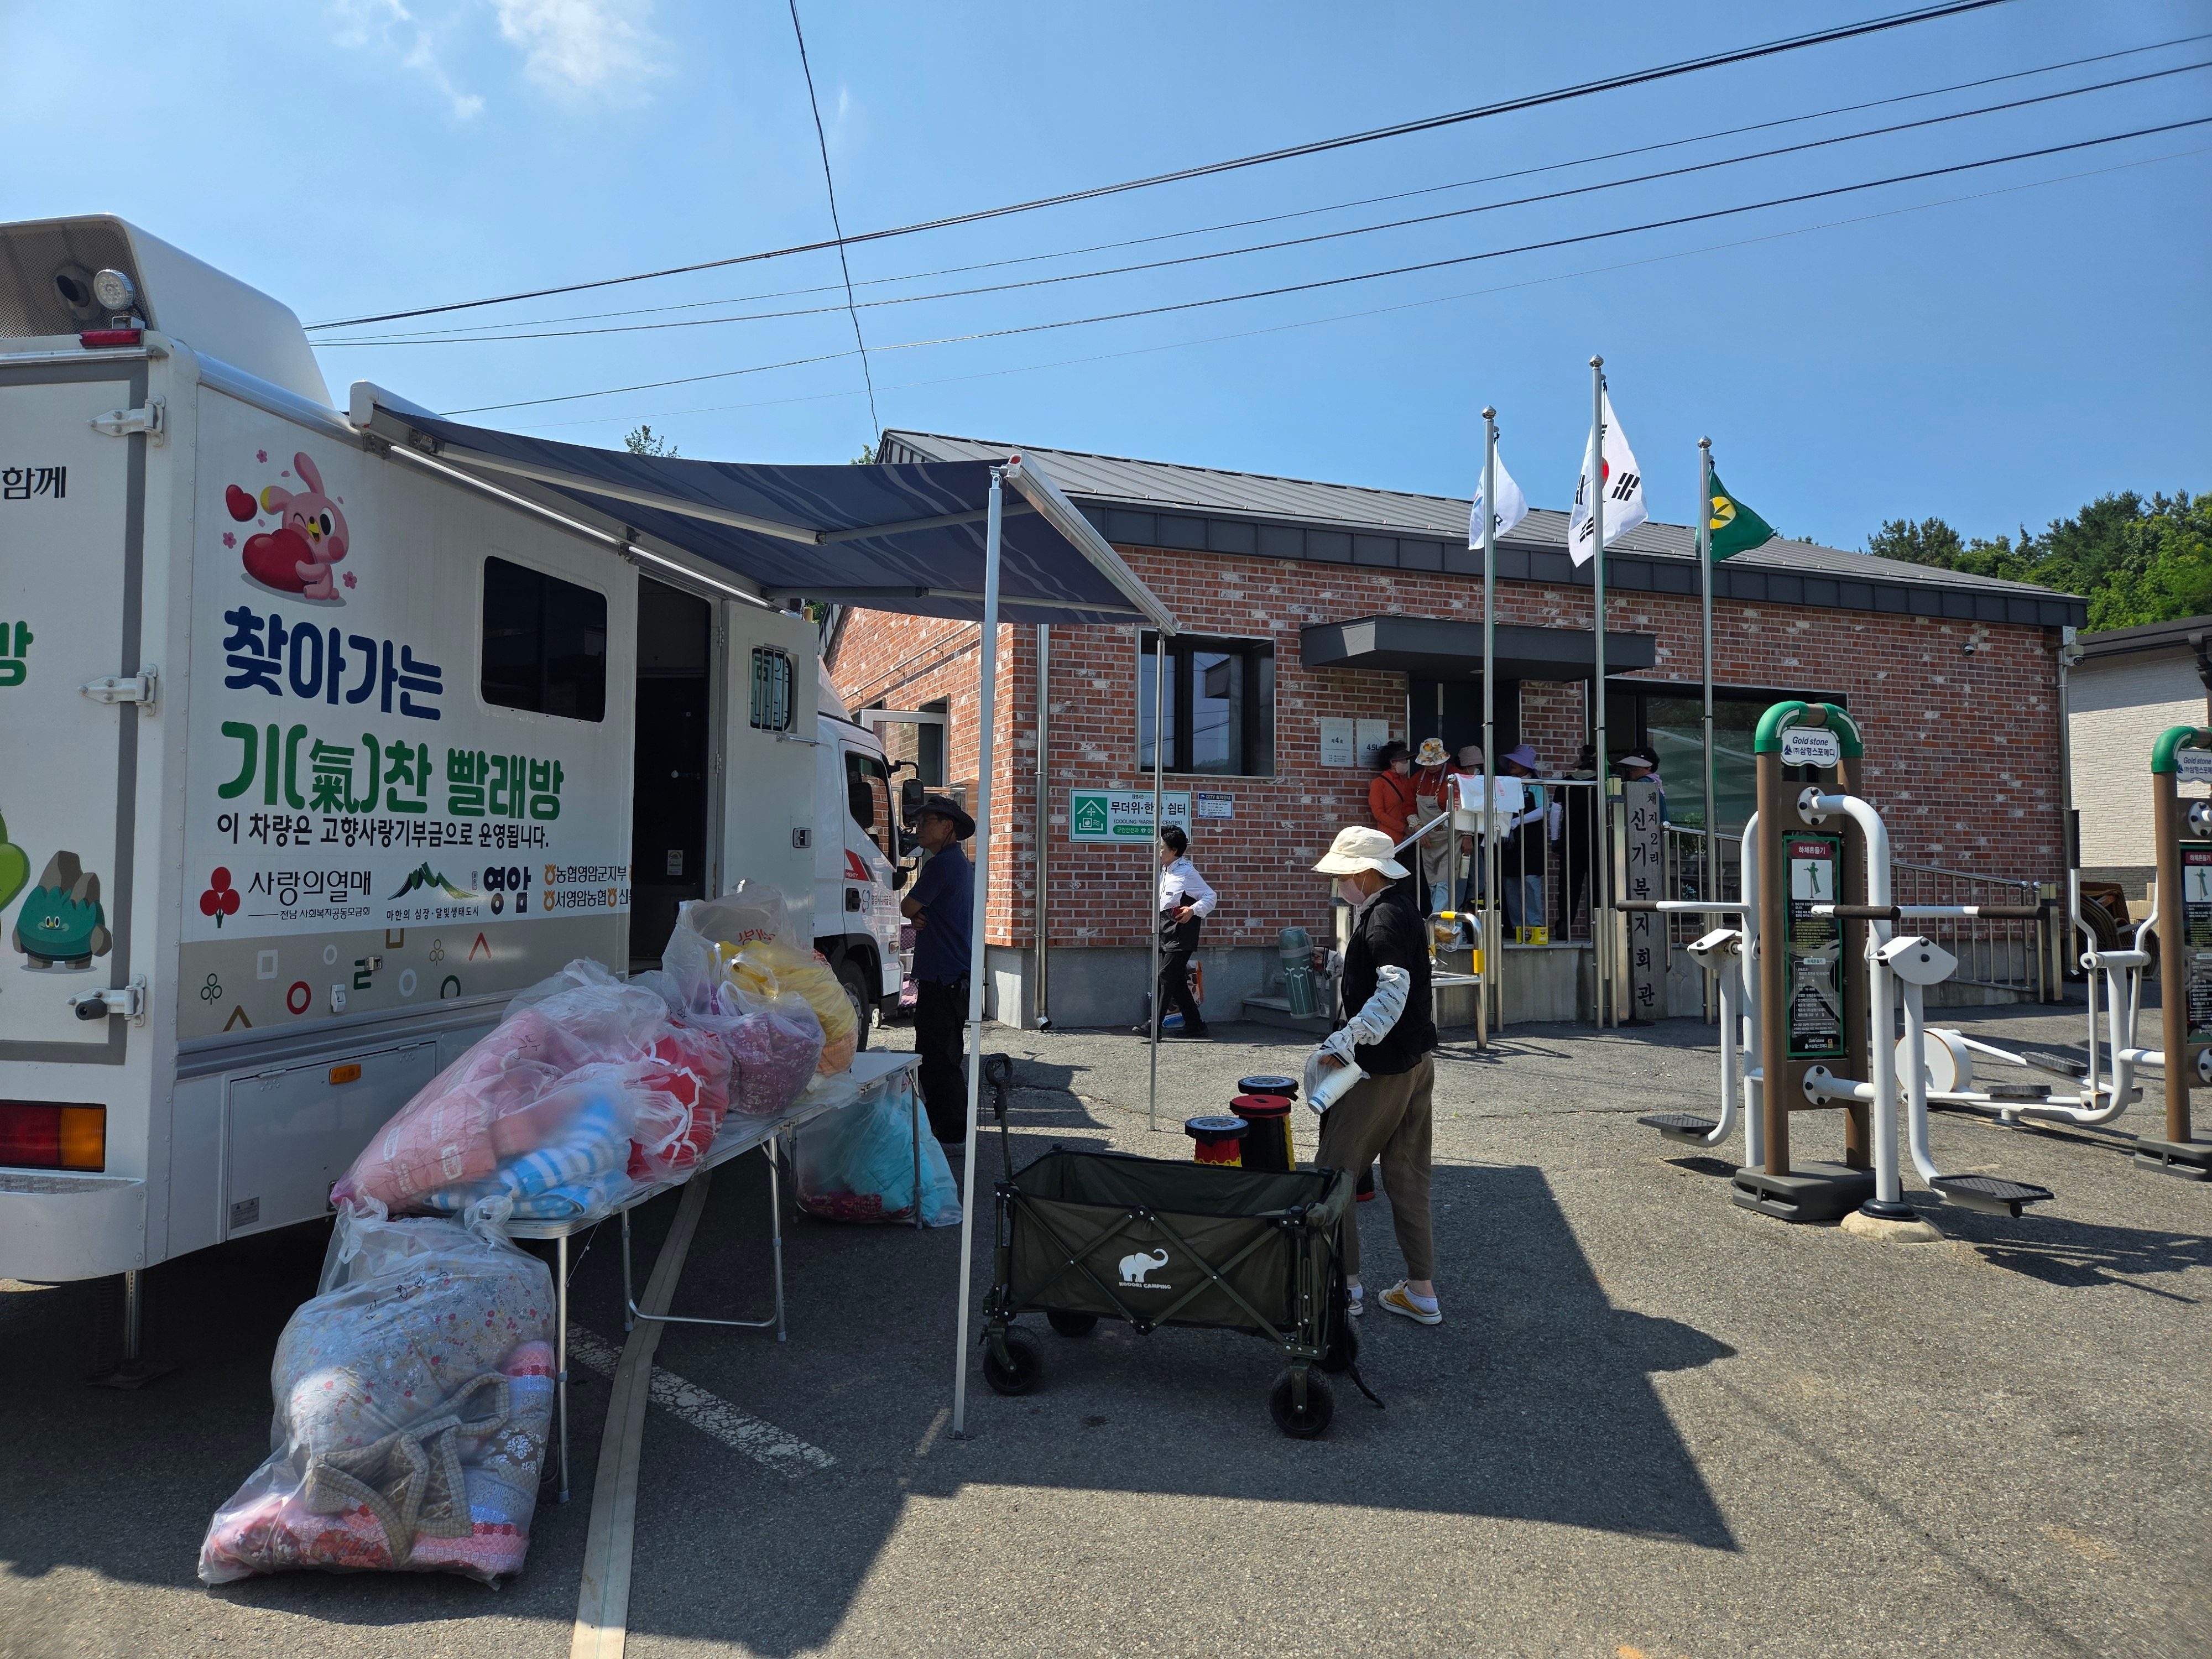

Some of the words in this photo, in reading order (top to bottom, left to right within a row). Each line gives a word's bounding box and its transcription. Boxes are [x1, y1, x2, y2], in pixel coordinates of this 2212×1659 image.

[2, 466, 66, 500] 함께
[223, 606, 443, 721] 찾아가는
[1792, 736, 1809, 744] Gold
[1793, 747, 1835, 757] (주)삼형스포메디
[218, 721, 432, 814] 기(氣)찬
[447, 748, 565, 821] 빨래방
[1167, 802, 1186, 816] 쉼터
[217, 812, 238, 844] 이
[248, 813, 312, 847] 차량은
[320, 816, 473, 848] 고향사랑기부금으로
[478, 822, 549, 849] 운영됩니다.
[1647, 792, 1659, 865] 채지2리
[1798, 846, 1825, 854] 하체흔들기
[556, 865, 627, 884] 농협영암군지부
[248, 870, 371, 906] 사랑의열매
[483, 867, 531, 915] 영암
[555, 889, 606, 908] 서영암농협
[280, 910, 297, 920] 전남
[299, 907, 370, 920] 사회복지공동모금회
[387, 909, 410, 921] 마한의
